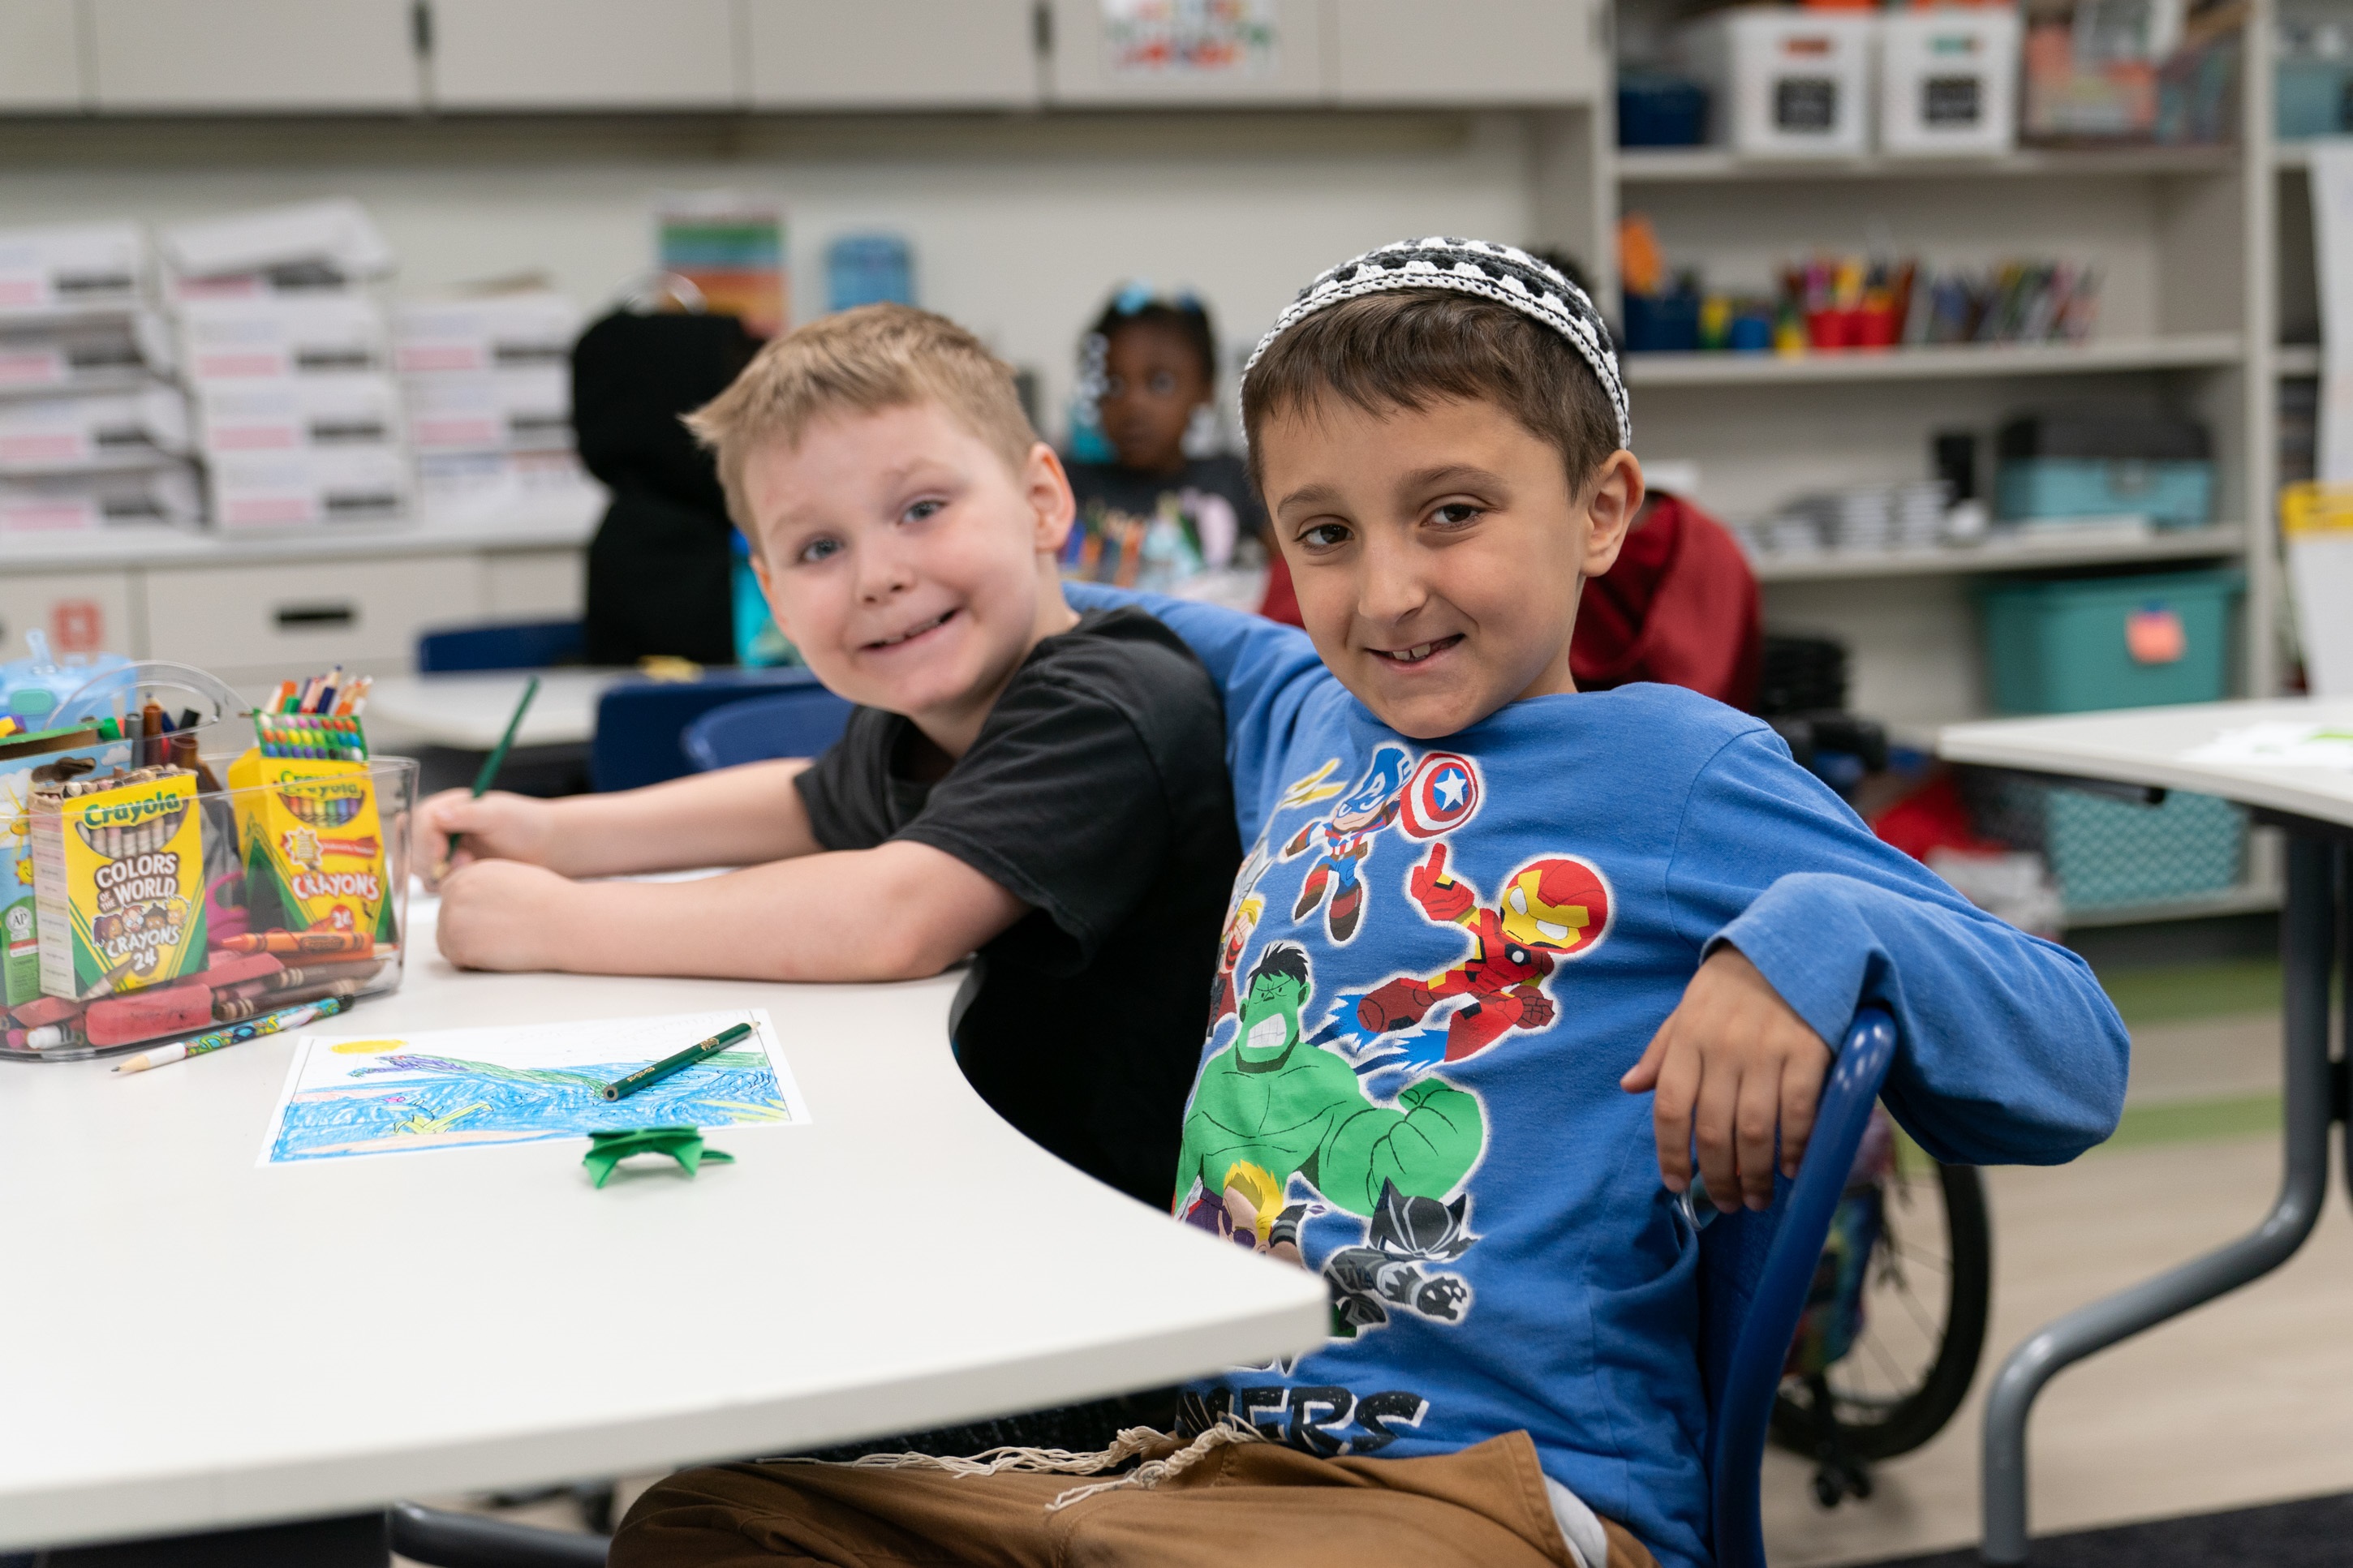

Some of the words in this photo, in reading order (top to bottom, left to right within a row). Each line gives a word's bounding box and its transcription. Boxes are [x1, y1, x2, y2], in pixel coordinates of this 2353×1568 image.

[84, 792, 180, 826] Crayola
[96, 854, 178, 888] COLORS
[99, 891, 111, 902] OF
[113, 877, 177, 904] WORLD
[293, 874, 380, 900] CRAYONS
[100, 900, 117, 911] THE
[14, 913, 28, 926] AP
[106, 925, 179, 958] CRAYONS
[133, 947, 157, 971] 24
